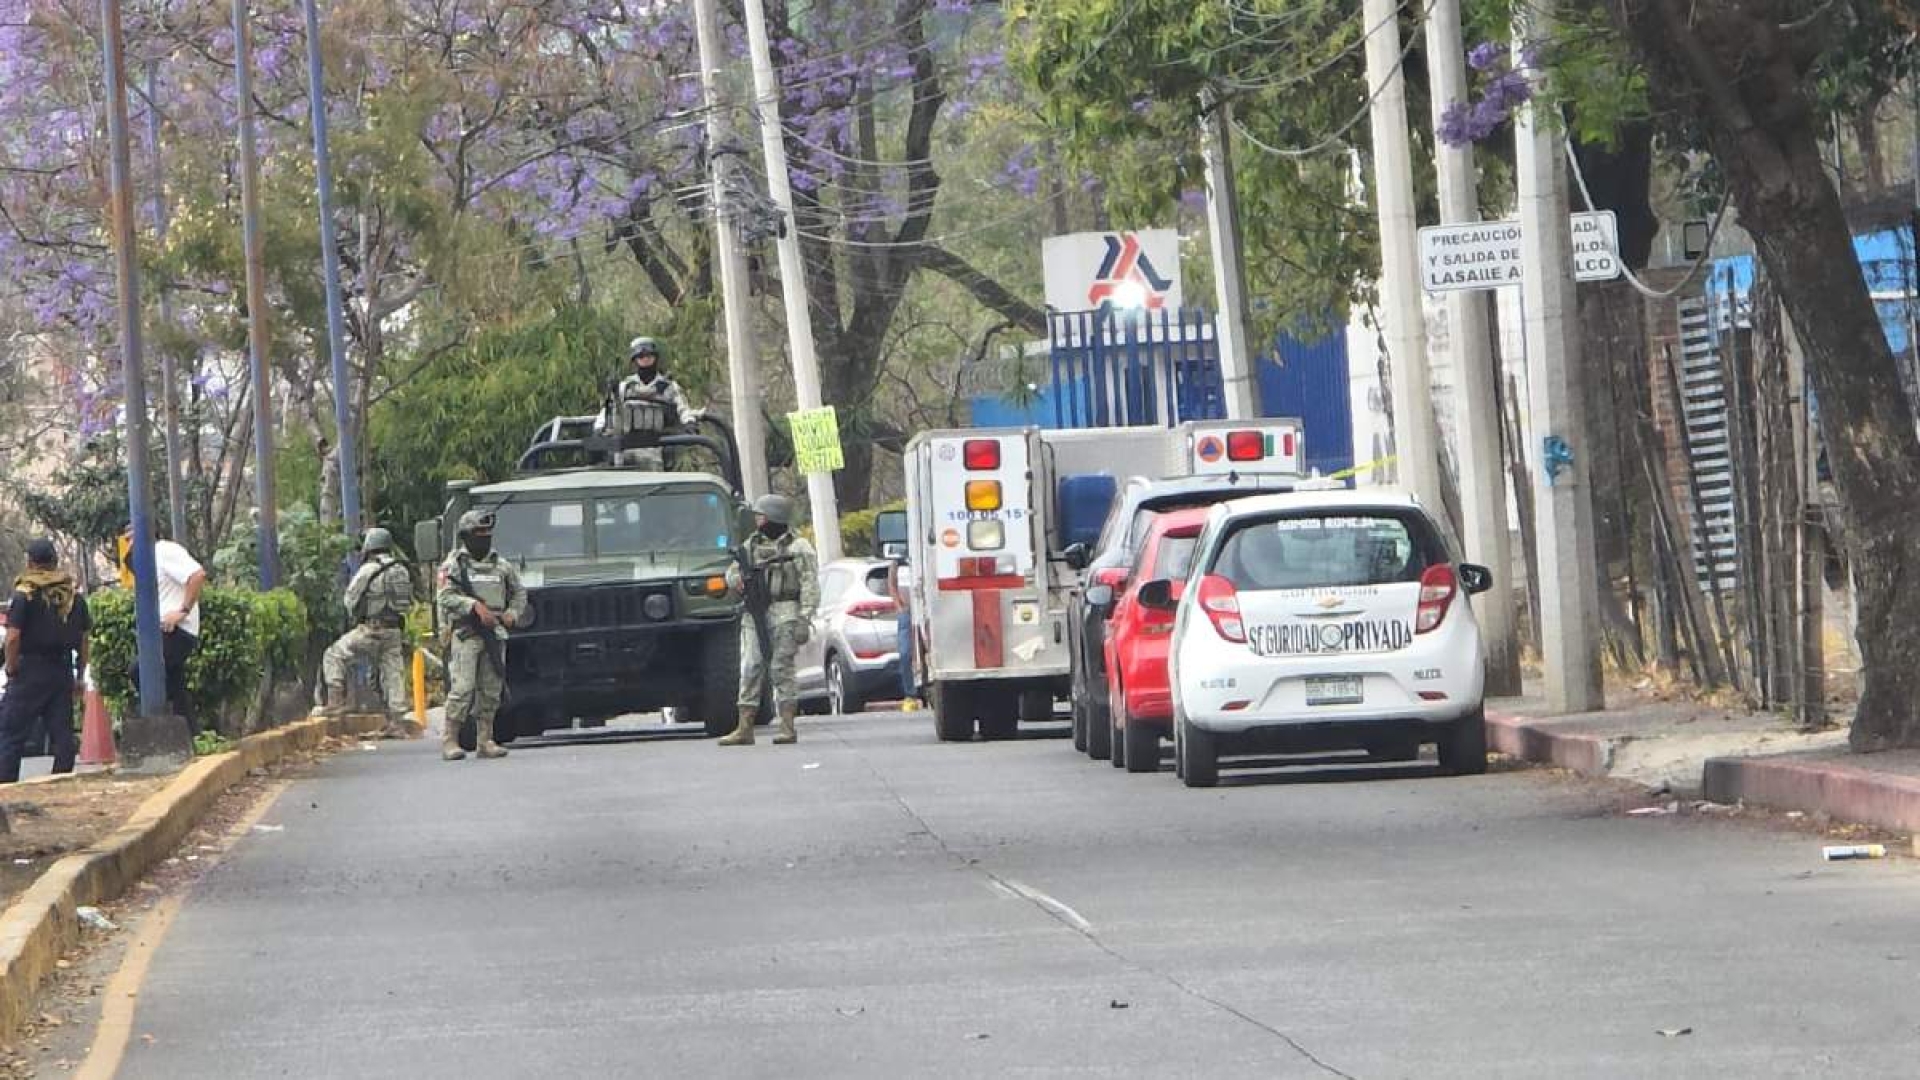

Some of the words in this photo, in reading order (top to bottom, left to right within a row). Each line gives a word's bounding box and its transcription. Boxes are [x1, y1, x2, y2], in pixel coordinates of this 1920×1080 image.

[1429, 255, 1437, 267] Y
[1443, 250, 1496, 265] SALIDA
[1249, 624, 1319, 656] SEGURIDAD
[1344, 620, 1412, 650] PRIVADA
